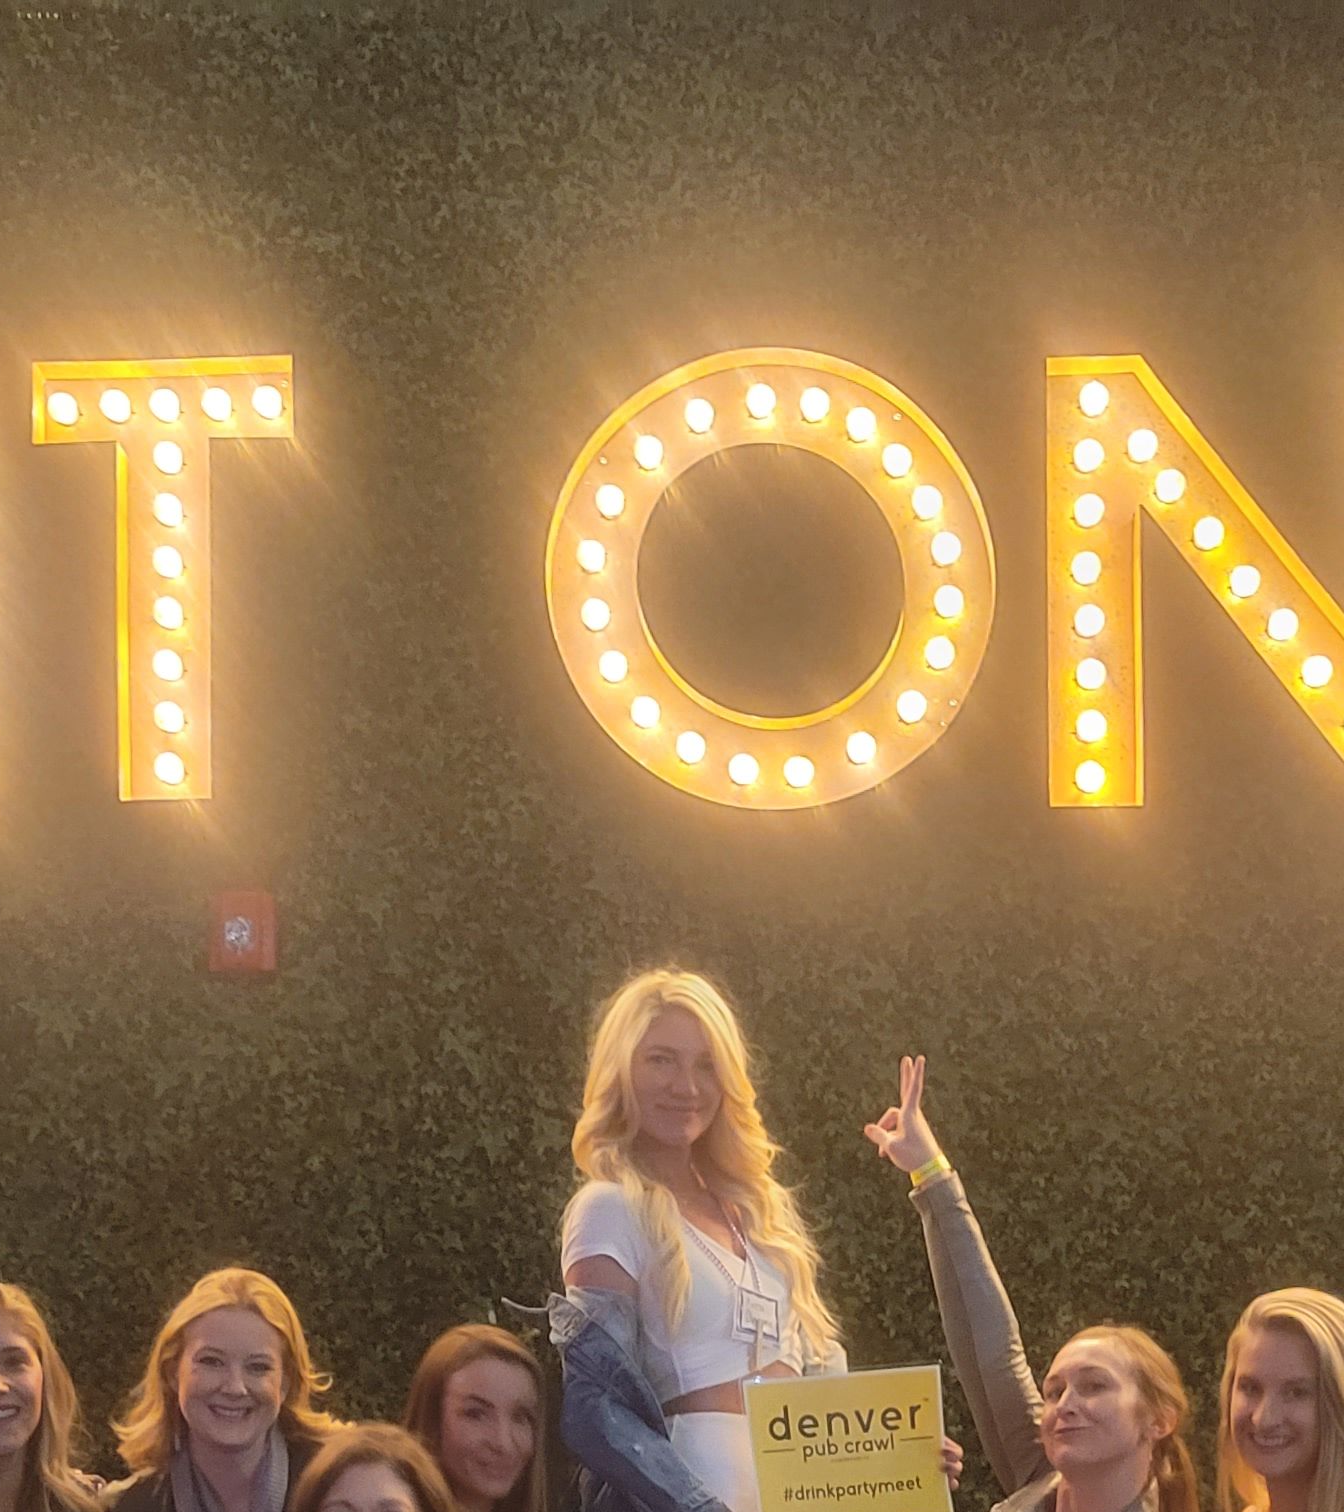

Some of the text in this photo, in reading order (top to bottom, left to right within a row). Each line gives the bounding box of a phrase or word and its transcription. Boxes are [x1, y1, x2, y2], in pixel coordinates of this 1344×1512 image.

[768, 1404, 922, 1441] denver
[802, 1432, 895, 1463] pub crawl
[784, 1475, 923, 1502] #drinkpartymeet
